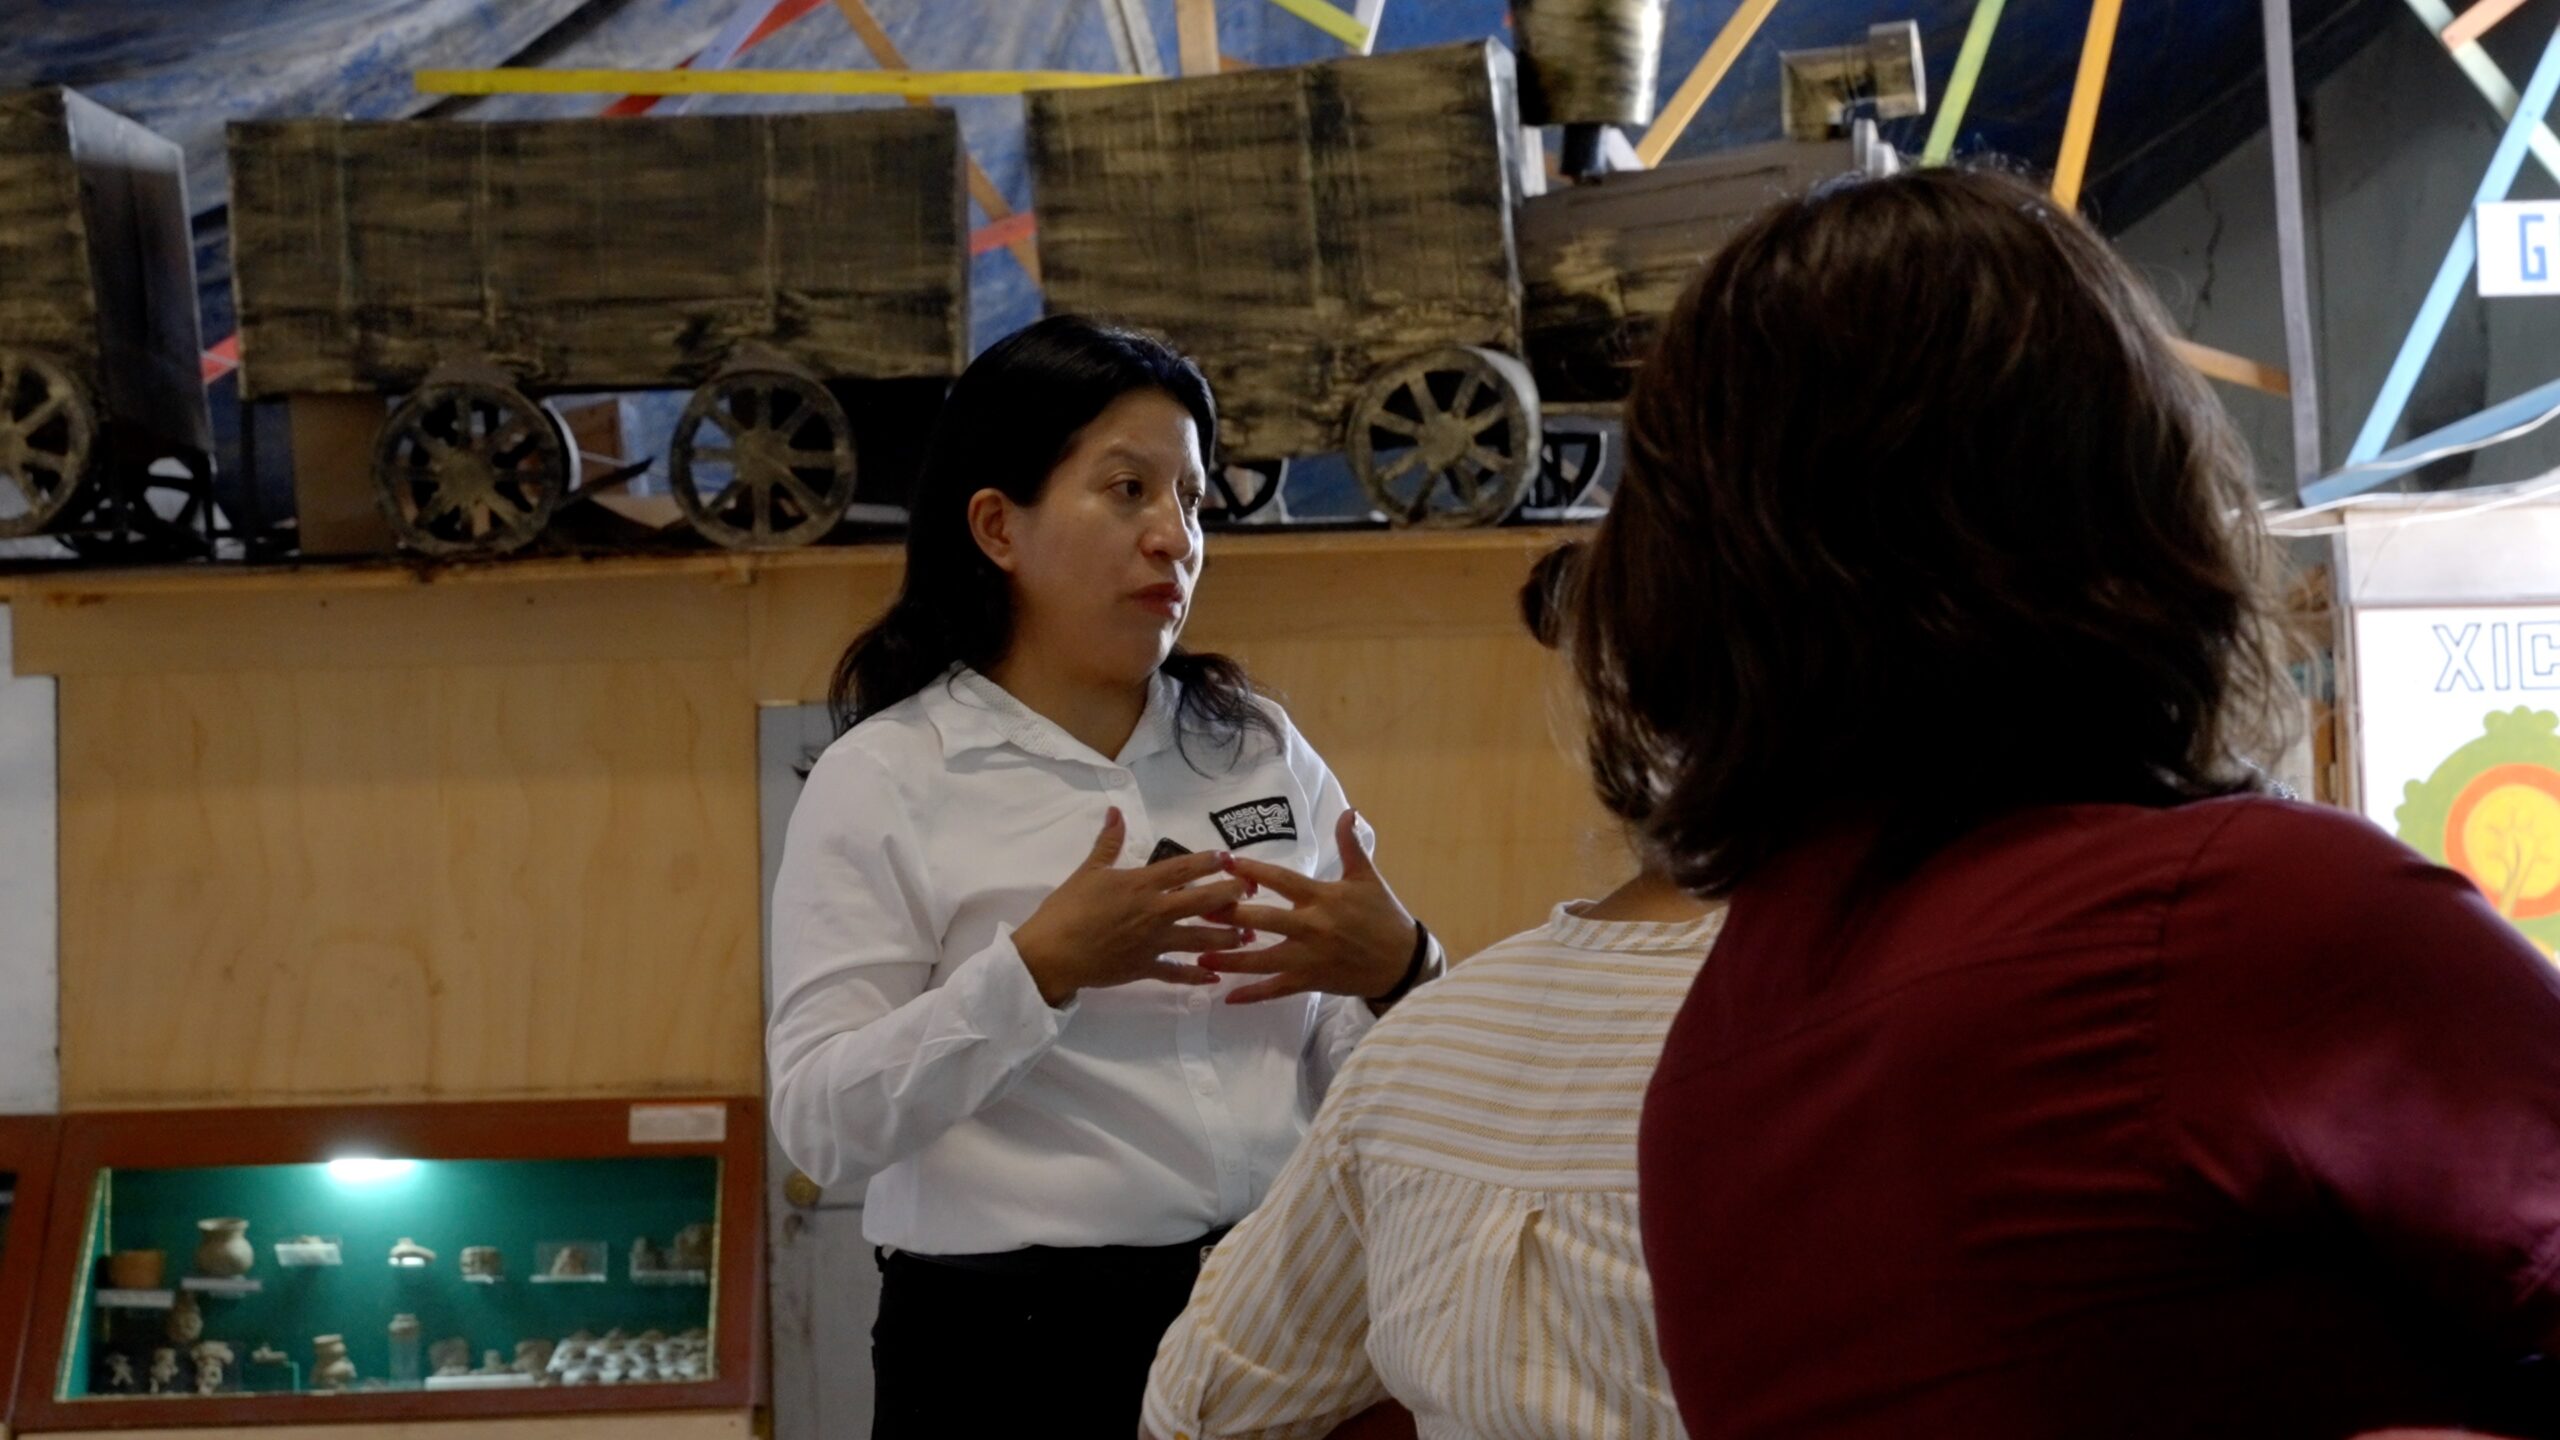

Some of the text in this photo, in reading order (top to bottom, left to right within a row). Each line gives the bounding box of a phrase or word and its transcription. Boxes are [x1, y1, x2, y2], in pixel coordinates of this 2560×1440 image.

[2432, 620, 2560, 692] XIC
[1219, 806, 1257, 824] MUSEO
[1226, 823, 1267, 843] XICO
